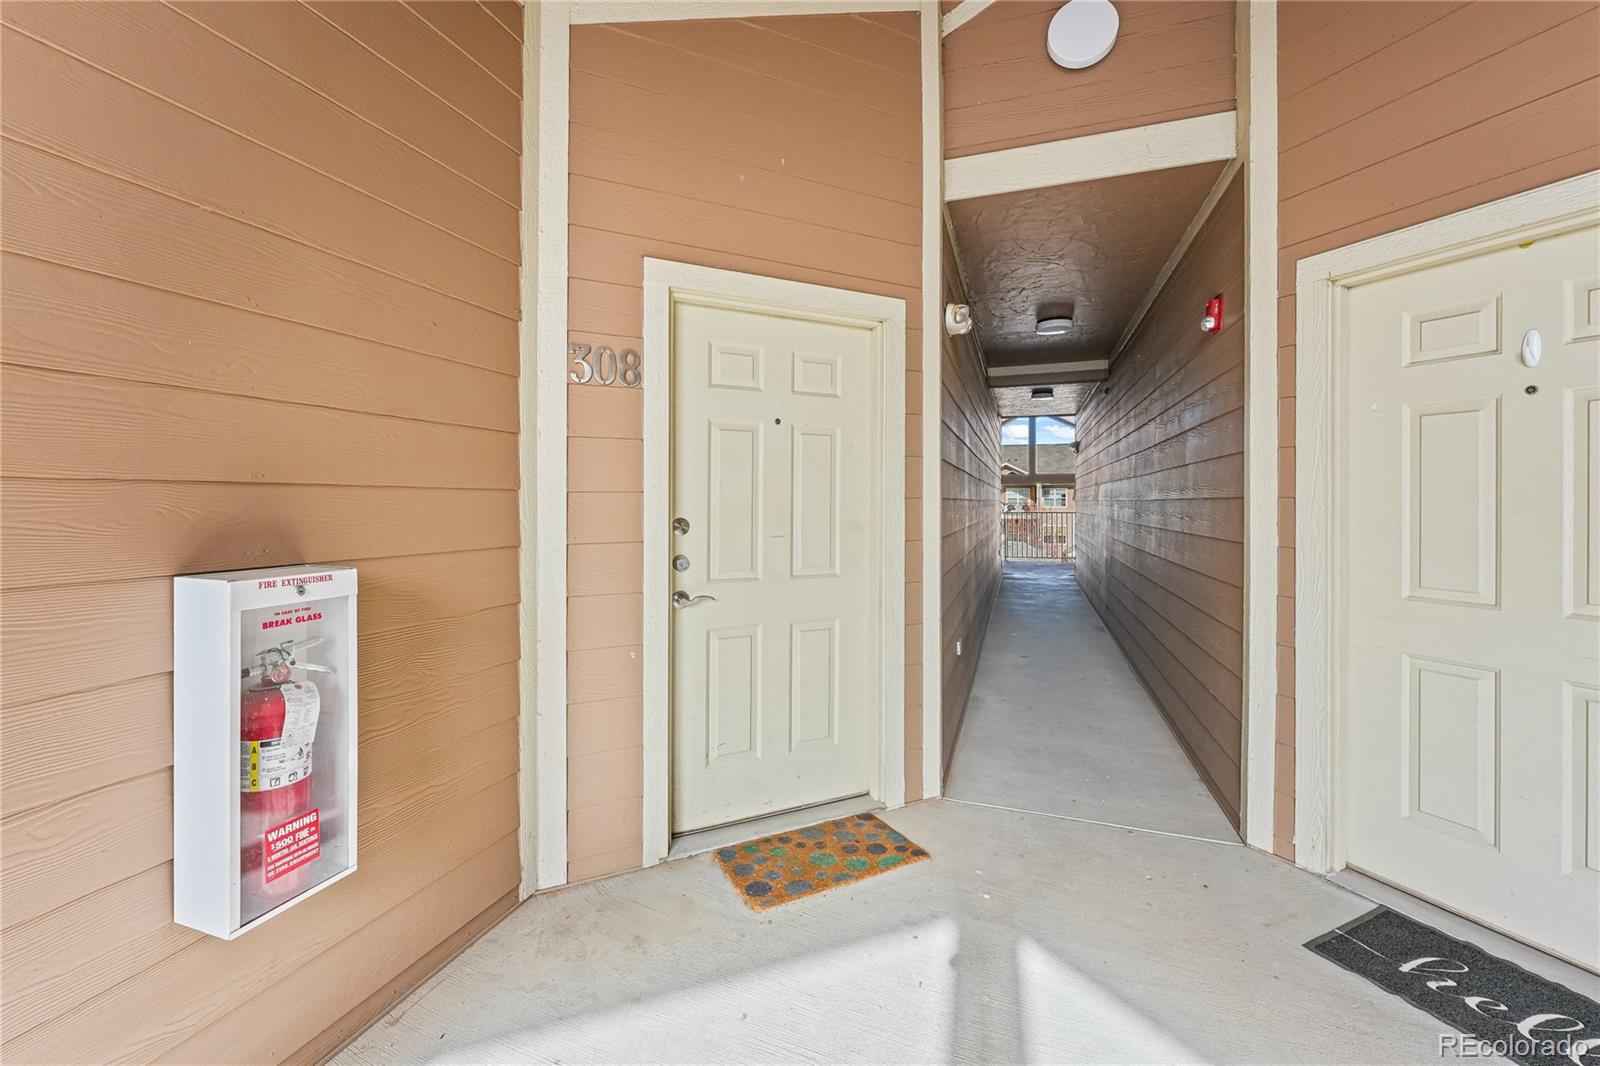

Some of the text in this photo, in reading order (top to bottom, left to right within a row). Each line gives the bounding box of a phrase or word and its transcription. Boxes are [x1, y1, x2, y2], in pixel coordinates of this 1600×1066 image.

[568, 343, 641, 388] 308
[258, 574, 334, 590] FIRE EXTINGUISHER
[262, 612, 323, 630] BREAK GLASS
[251, 746, 257, 754] A
[251, 763, 257, 771] B
[251, 779, 257, 787] C
[267, 812, 317, 842] WARNING
[270, 835, 294, 851] $500
[295, 827, 310, 842] FINE
